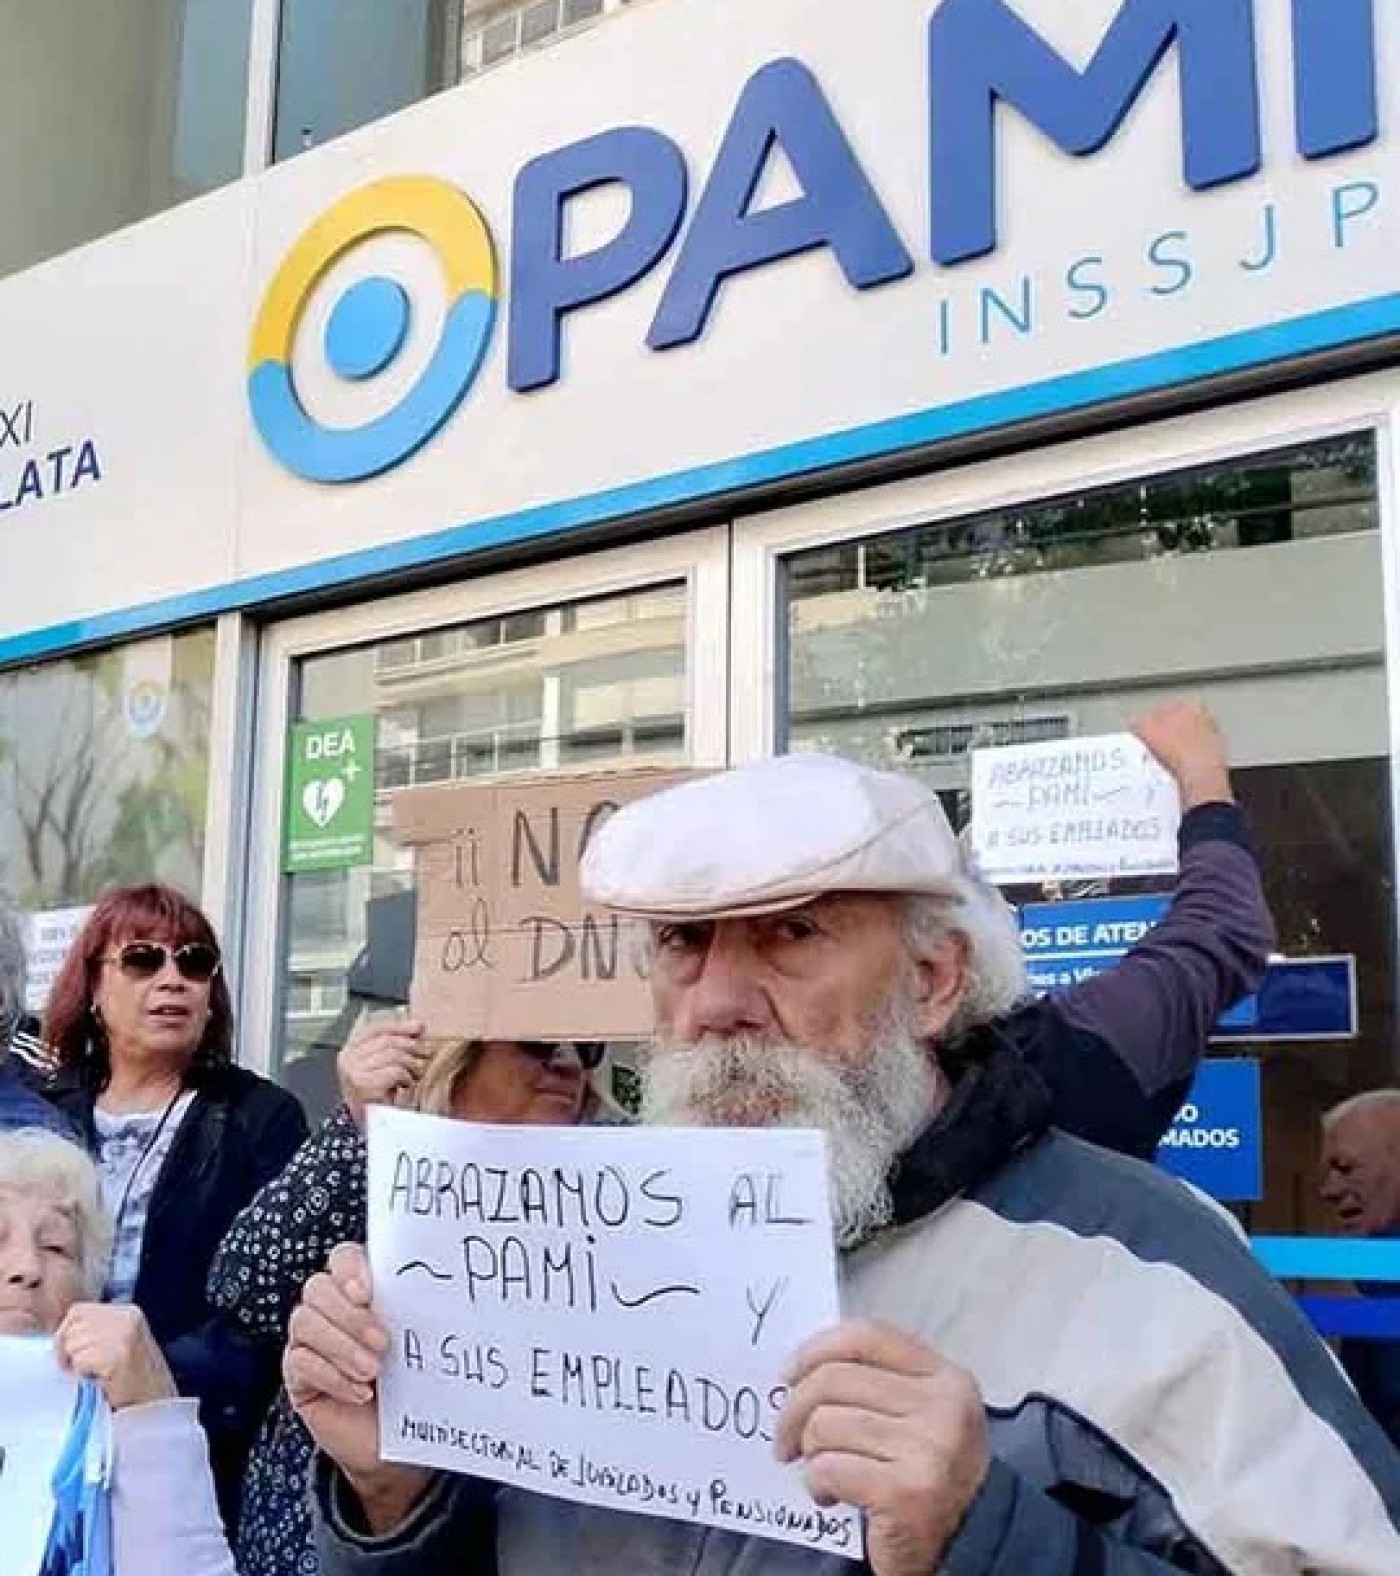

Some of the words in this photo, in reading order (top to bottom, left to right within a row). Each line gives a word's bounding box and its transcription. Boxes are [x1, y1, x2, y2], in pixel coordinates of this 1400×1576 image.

[507, 0, 1377, 393] PAMI
[306, 729, 356, 760] DEA
[1057, 926, 1089, 945] DE
[389, 1151, 683, 1228] ABRAZAMOS
[729, 1172, 812, 1226] AL
[403, 1328, 424, 1371] A
[440, 1334, 509, 1389] SUS
